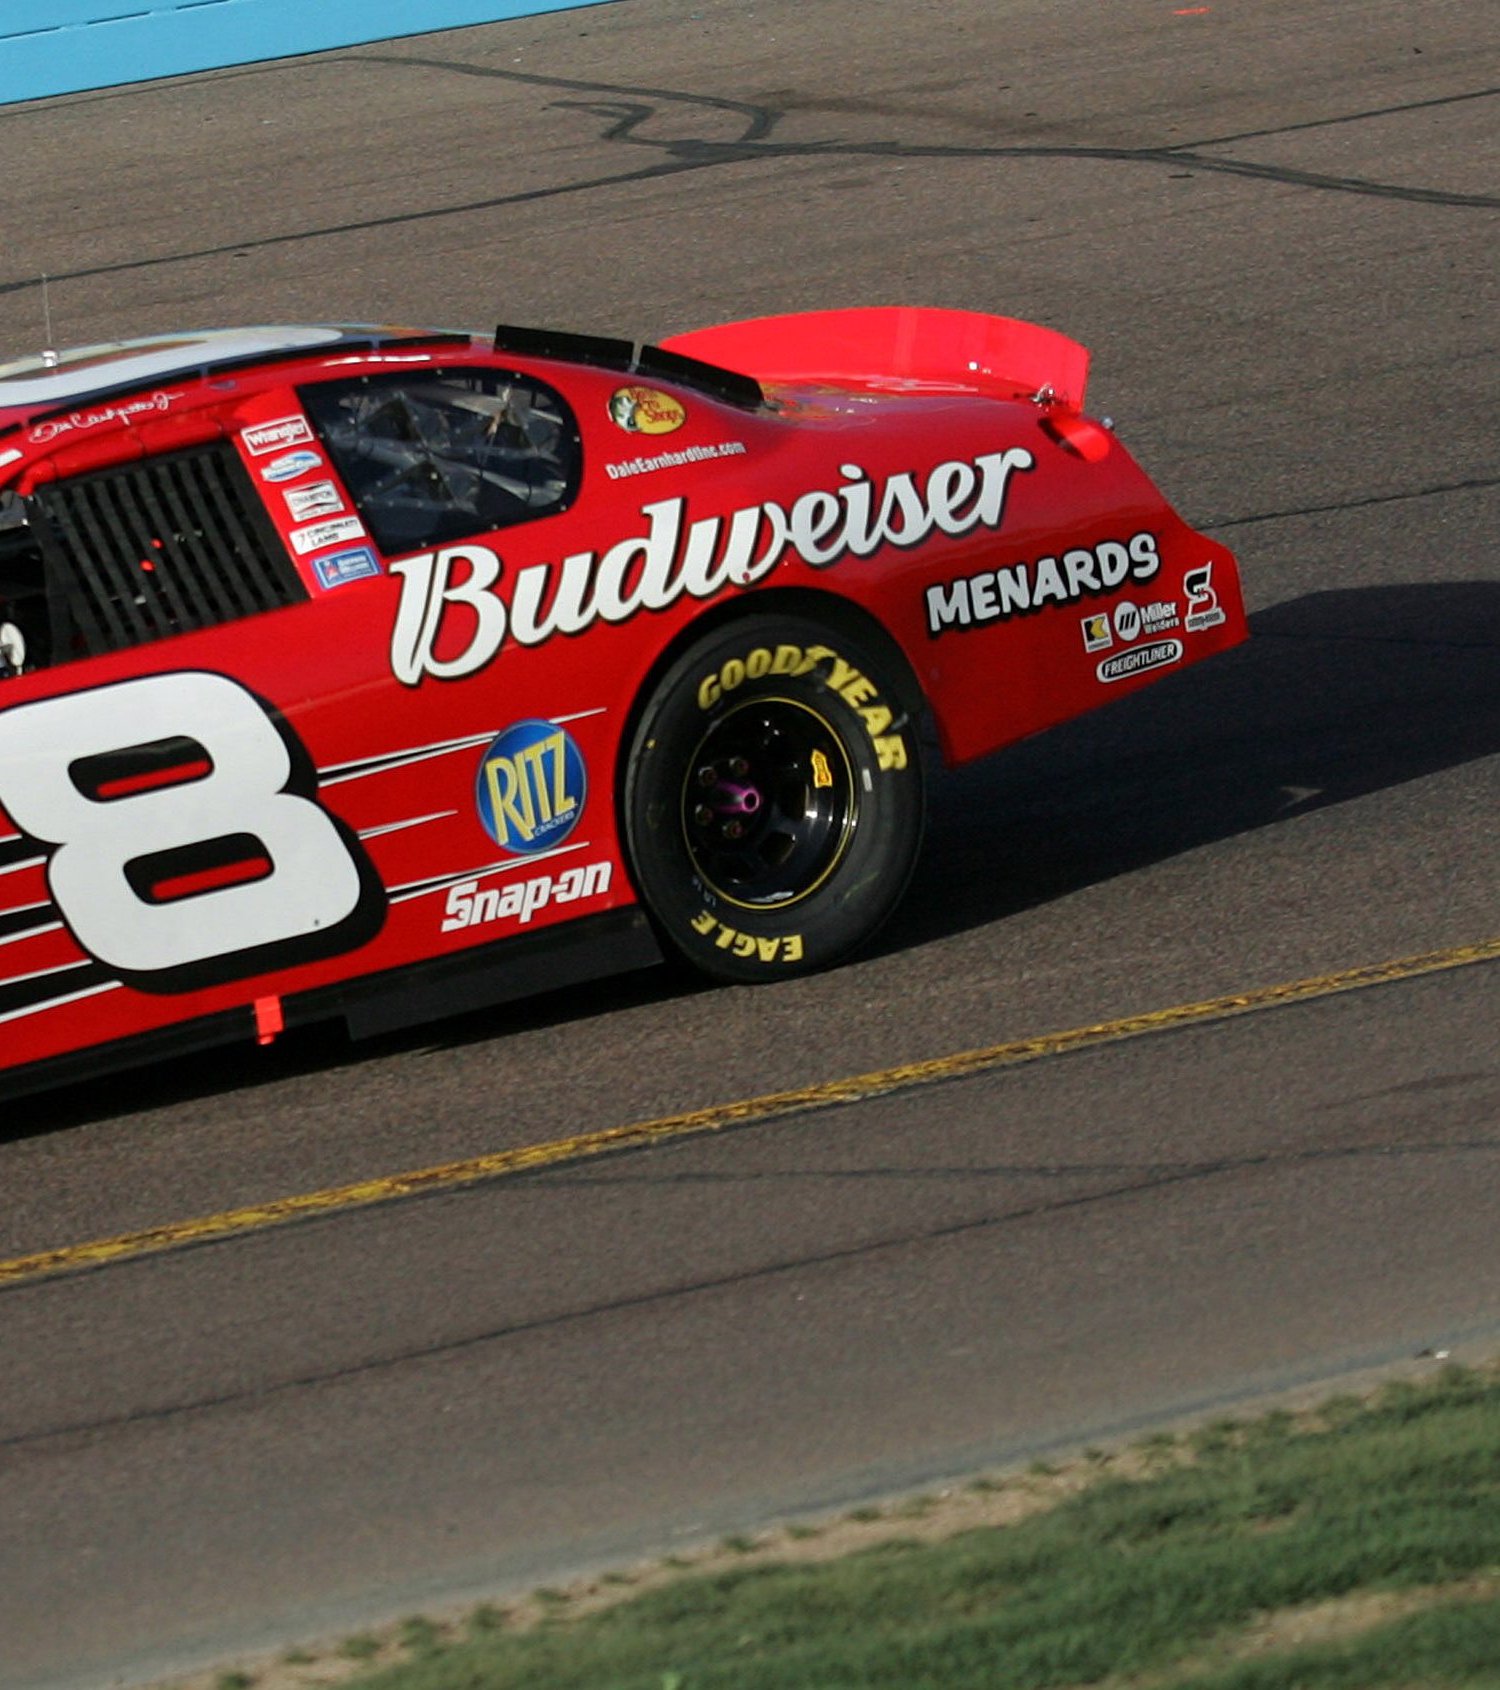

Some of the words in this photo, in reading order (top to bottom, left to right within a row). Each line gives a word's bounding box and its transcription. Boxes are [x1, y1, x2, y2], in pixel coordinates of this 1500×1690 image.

[248, 423, 305, 446] Wrangler
[604, 441, 746, 480] DaleEarnhardtInc.com
[389, 446, 1033, 687] Budweiser
[926, 532, 1160, 633] MENARDS
[1140, 602, 1177, 624] Miller
[1103, 643, 1175, 677] FREIGHTLINER
[698, 645, 907, 771] GOODYEAR
[485, 730, 577, 846] RITZ
[441, 861, 612, 932] Snap-on
[690, 909, 804, 962] EAGLE
